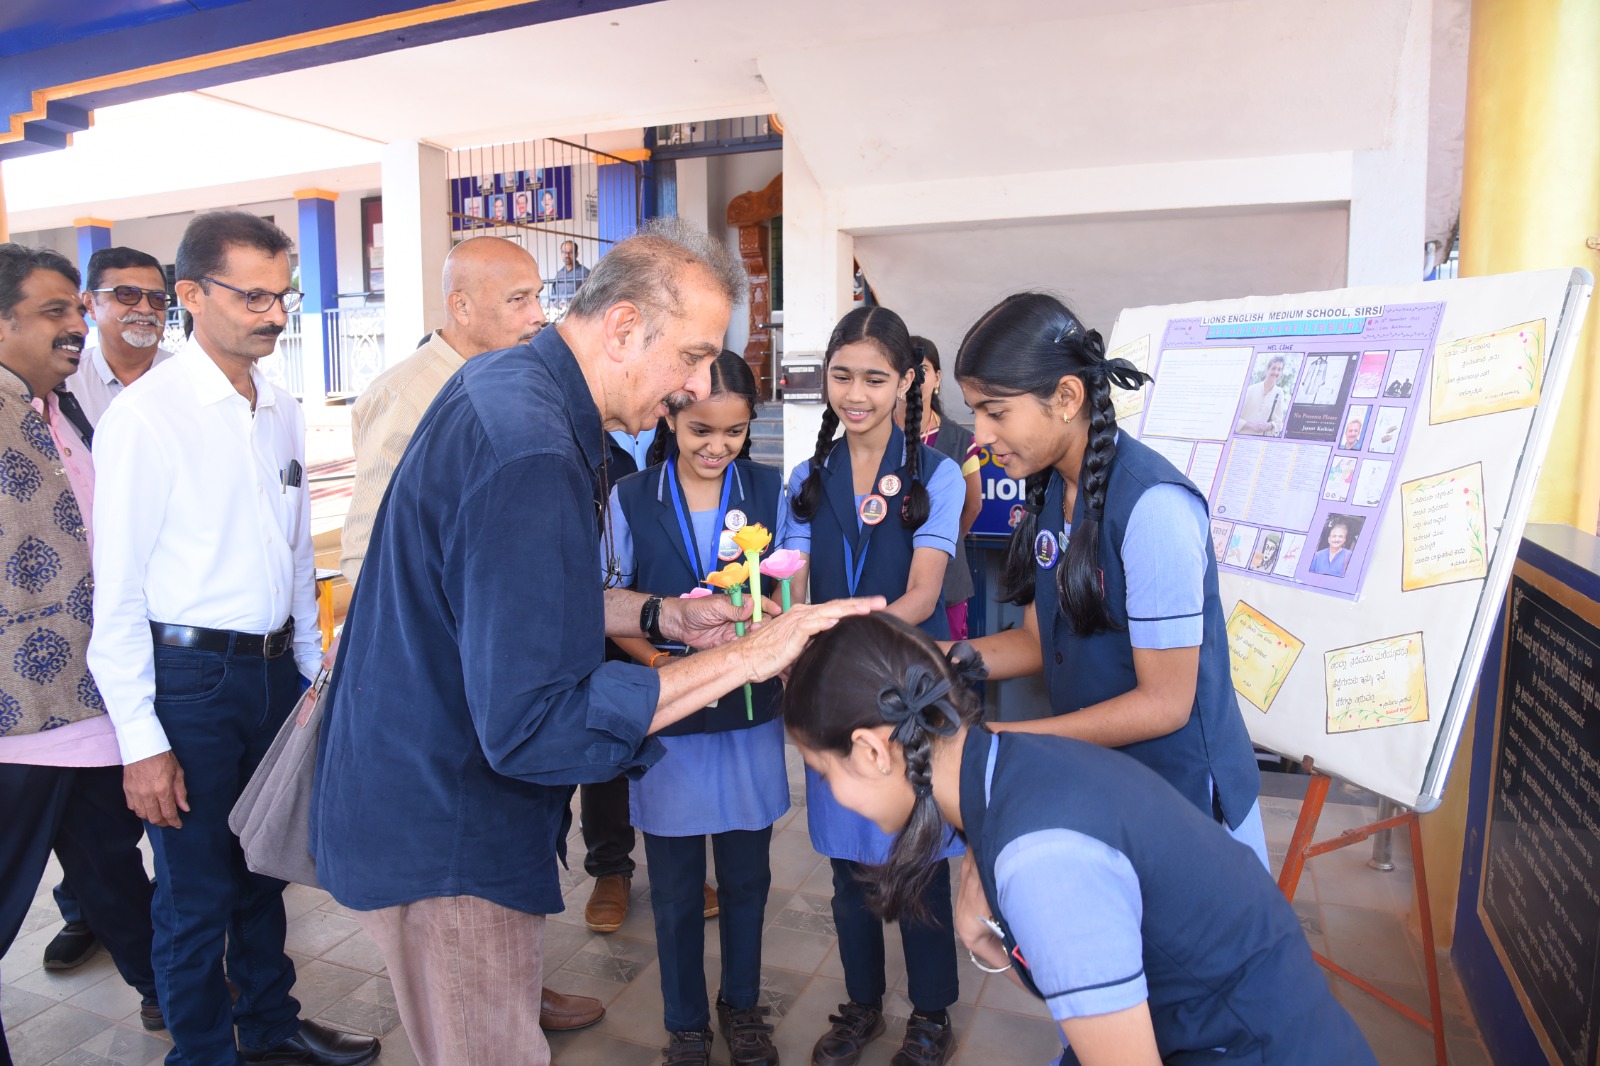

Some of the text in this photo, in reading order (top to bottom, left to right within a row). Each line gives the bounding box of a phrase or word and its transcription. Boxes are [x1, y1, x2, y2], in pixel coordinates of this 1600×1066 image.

[1228, 314, 1264, 323] ENGLISH
[1268, 310, 1304, 320] MEDIUM
[1306, 308, 1350, 318] SCHOOL,
[1354, 306, 1383, 316] SIRSI
[1304, 321, 1364, 332] LIBRARY
